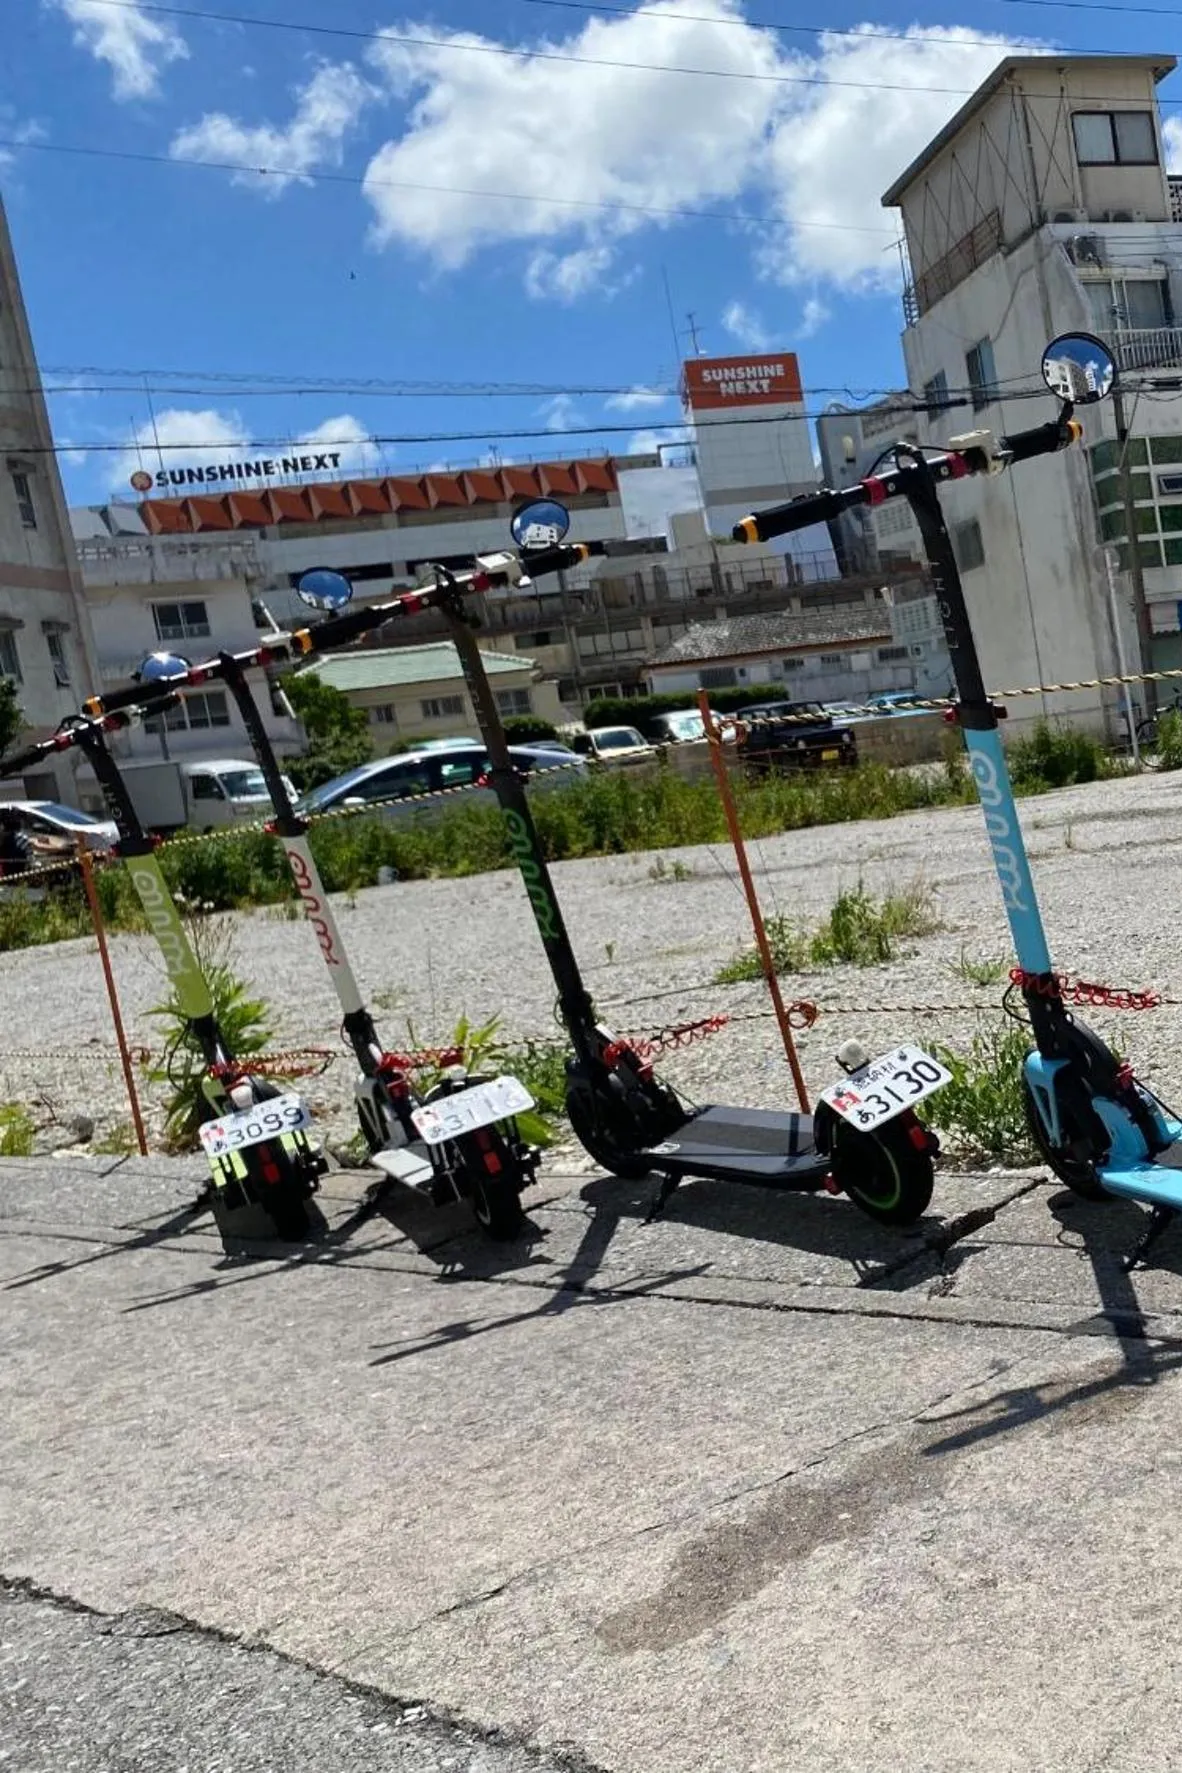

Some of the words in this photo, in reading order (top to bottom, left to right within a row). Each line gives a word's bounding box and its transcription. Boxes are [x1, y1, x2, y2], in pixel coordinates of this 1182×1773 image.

[702, 364, 785, 382] SUNSHINE
[720, 379, 771, 396] NEXT
[155, 460, 275, 487] SUNSHINE
[281, 453, 341, 474] NEXT
